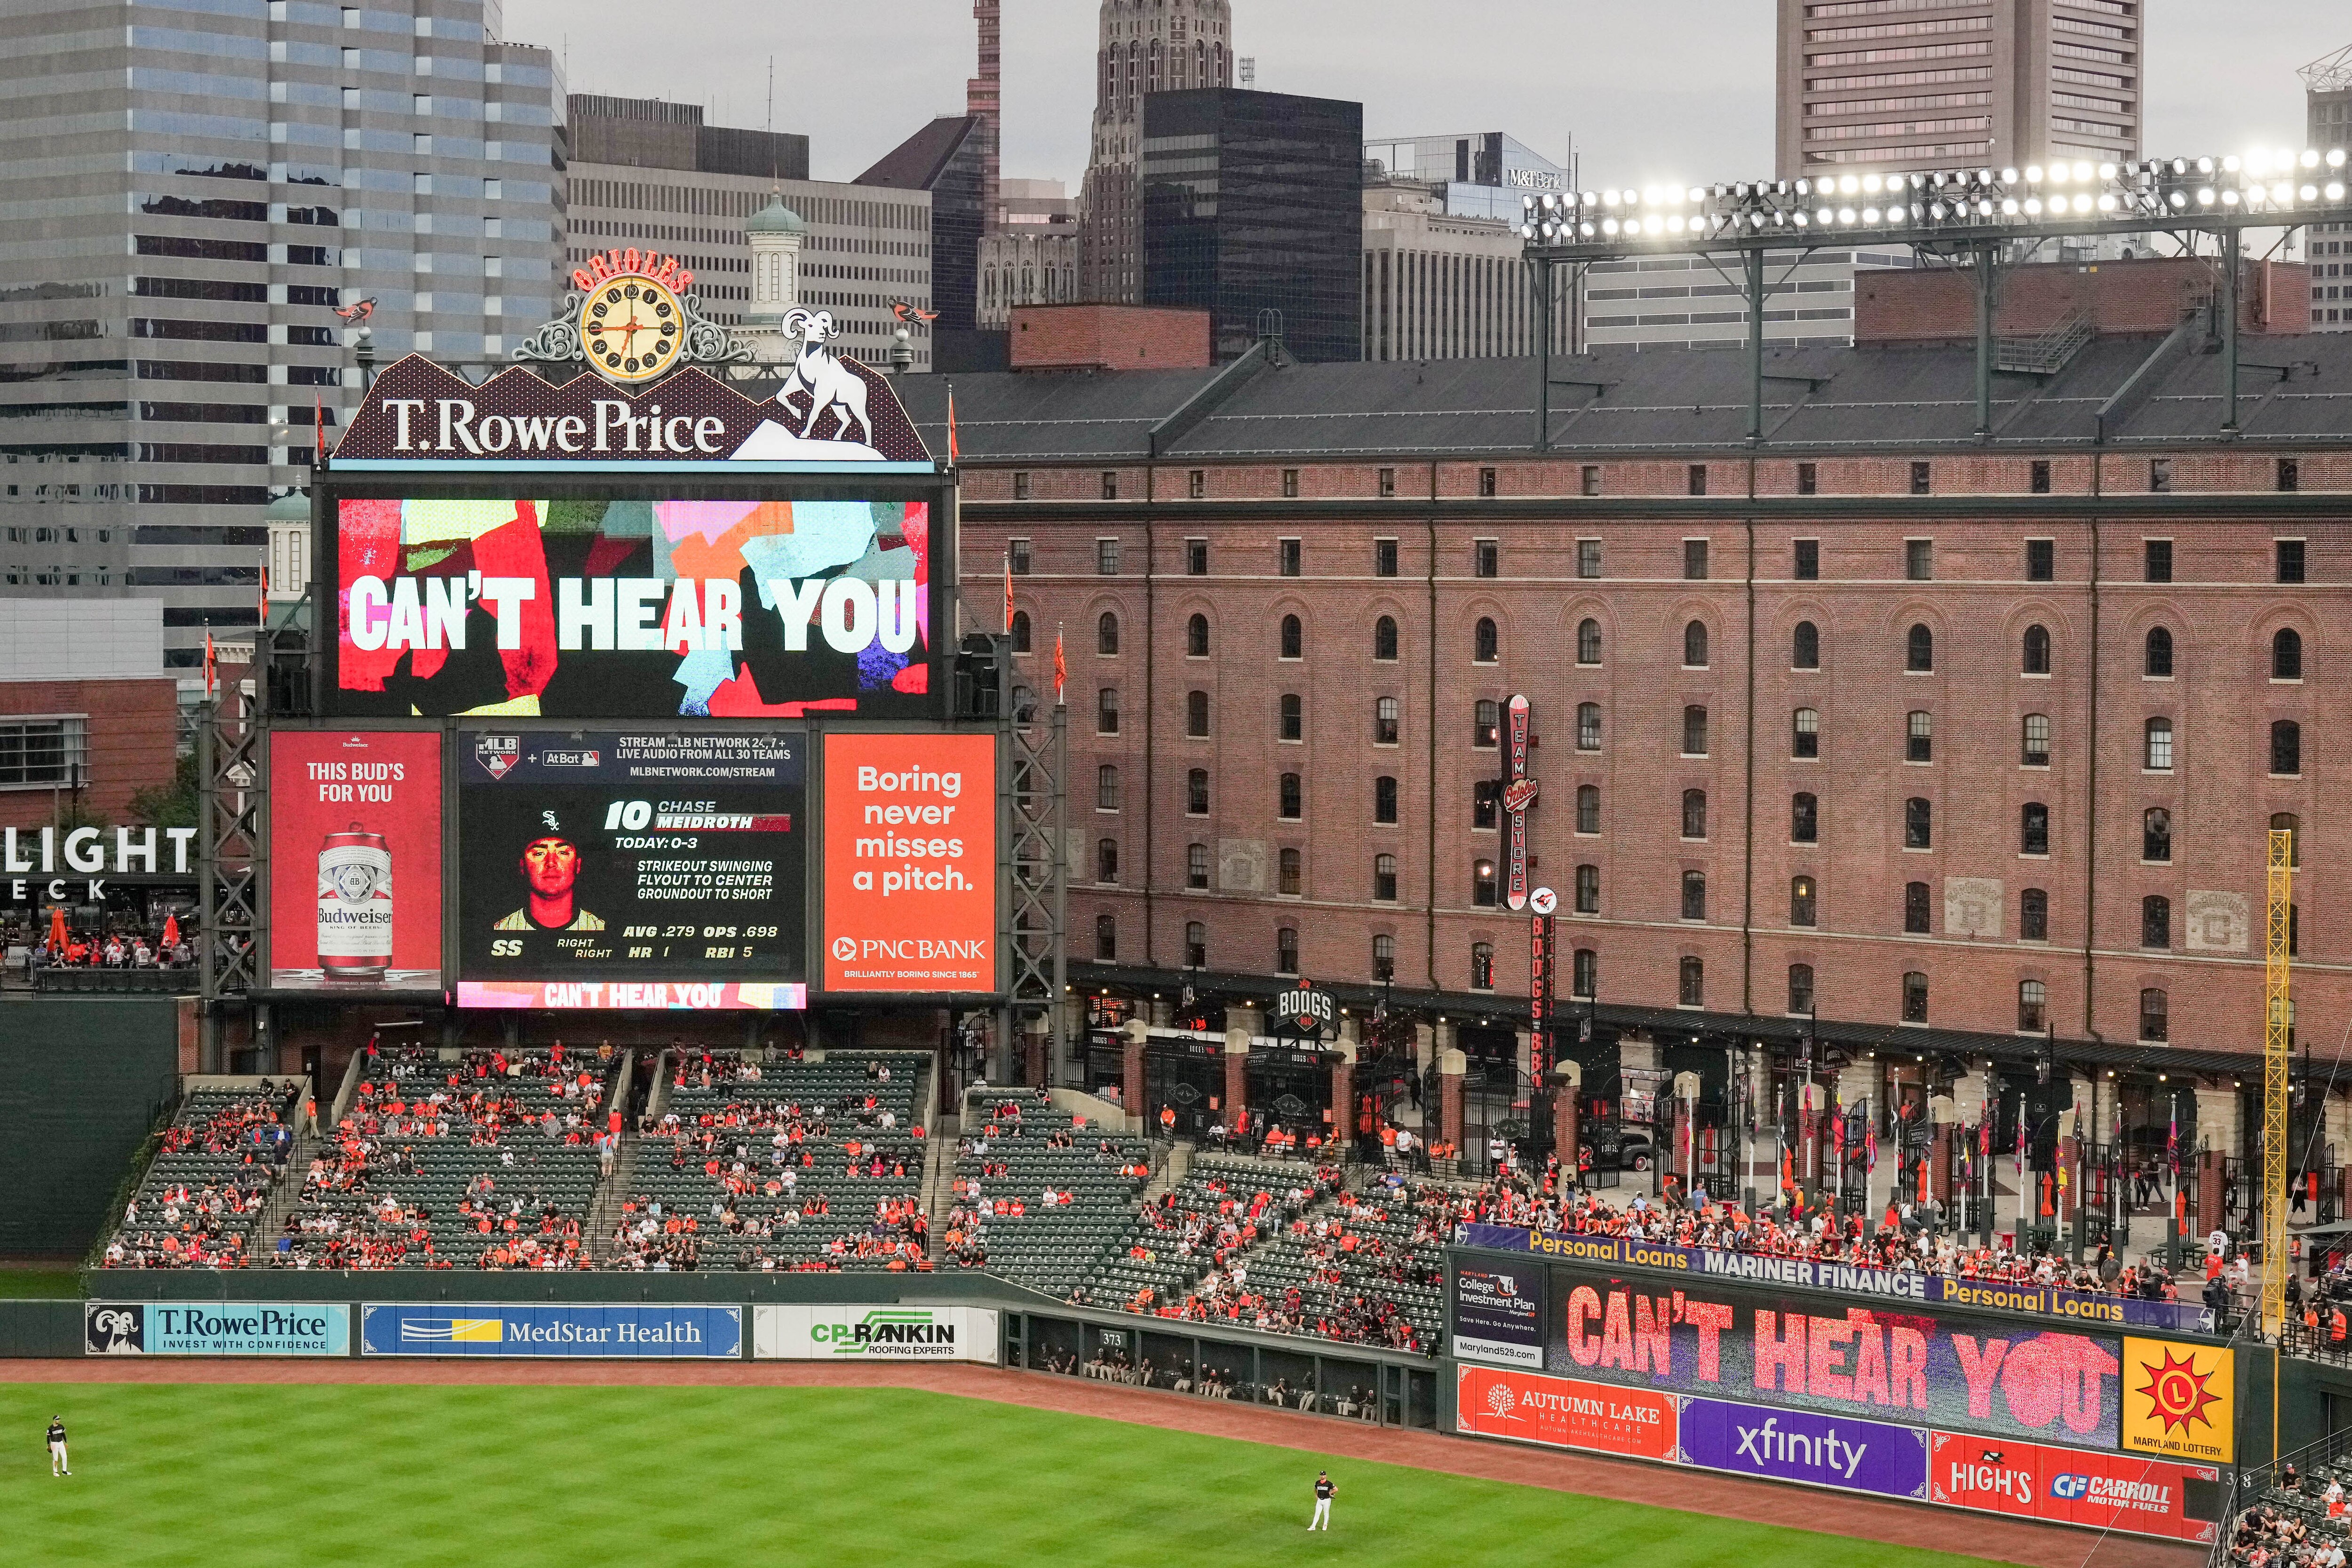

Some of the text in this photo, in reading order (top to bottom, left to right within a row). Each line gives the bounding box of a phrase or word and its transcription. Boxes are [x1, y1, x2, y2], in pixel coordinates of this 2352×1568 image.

[1509, 169, 1561, 190] M&T Bank
[572, 247, 694, 293] ORIOLES
[349, 570, 916, 654] CAN'T HEAR YOU
[477, 737, 517, 750] MLB
[619, 737, 665, 748] STREAM
[668, 737, 691, 748] LB
[693, 737, 750, 748] NETWORK
[1515, 714, 1524, 774] TEAM
[617, 749, 791, 760] LIVE AUDIO FROM ALL 30 TEAMS
[307, 763, 405, 781] THIS BUD'S
[630, 767, 775, 778] MLBNETWORK.COM/STREAM
[858, 764, 961, 798] Boring
[319, 784, 392, 802] FOR YOU
[1505, 780, 1537, 805] Orioles
[604, 800, 717, 830] 10 CHASE
[657, 816, 753, 829] MEIDROTH
[865, 805, 955, 824] never
[615, 837, 698, 849] TODAY: 0-3
[856, 831, 963, 857] misses
[1512, 816, 1523, 891] STORE
[637, 860, 772, 872] STRIKEOUT SWINGING
[637, 874, 772, 886] FLYOUT TO CENTER
[853, 863, 973, 897] a pitch.
[637, 888, 773, 900] GROUNDOUT TO SHORT
[318, 908, 392, 923] Budweiser
[622, 926, 779, 938] AVG .279 OPS .698
[491, 940, 523, 957] SS
[556, 938, 595, 947] RIGHT
[628, 946, 652, 958] HR
[705, 946, 735, 958] RBI
[742, 946, 753, 958] 5
[861, 940, 986, 959] PNC BANK
[575, 949, 612, 958] RIGHT
[545, 982, 721, 1007] CAN'T HEAR YOU
[1279, 990, 1331, 1021] BOOG'S
[1300, 1017, 1311, 1026] BBQ
[1529, 1230, 1687, 1269] Personal Loans
[1704, 1251, 1925, 1298] MARINER FINANCE
[1459, 1277, 1494, 1294] College
[1460, 1290, 1535, 1311] Investment Plan
[1943, 1279, 2123, 1321] Personal Loans
[509, 1322, 702, 1343] MedStar Health
[855, 1324, 954, 1343] RANKIN
[1503, 1322, 1536, 1332] Anywhere.
[1103, 1333, 1121, 1346] 373
[1460, 1342, 1535, 1360] Maryland529.com
[1567, 1286, 2107, 1433] CAN'T HEAR YOU
[2172, 1382, 2186, 1403] L
[1521, 1391, 1660, 1425] AUTUMN LAKE
[1540, 1412, 1641, 1434] HEALTHCARE
[1736, 1418, 1867, 1478] xfinity
[2134, 1436, 2222, 1456] MARYLAND LOTTERY
[1951, 1461, 2032, 1504] HIGH'S
[2089, 1476, 2170, 1505] CARROLL
[2087, 1495, 2169, 1513] MOTOR FUELS
